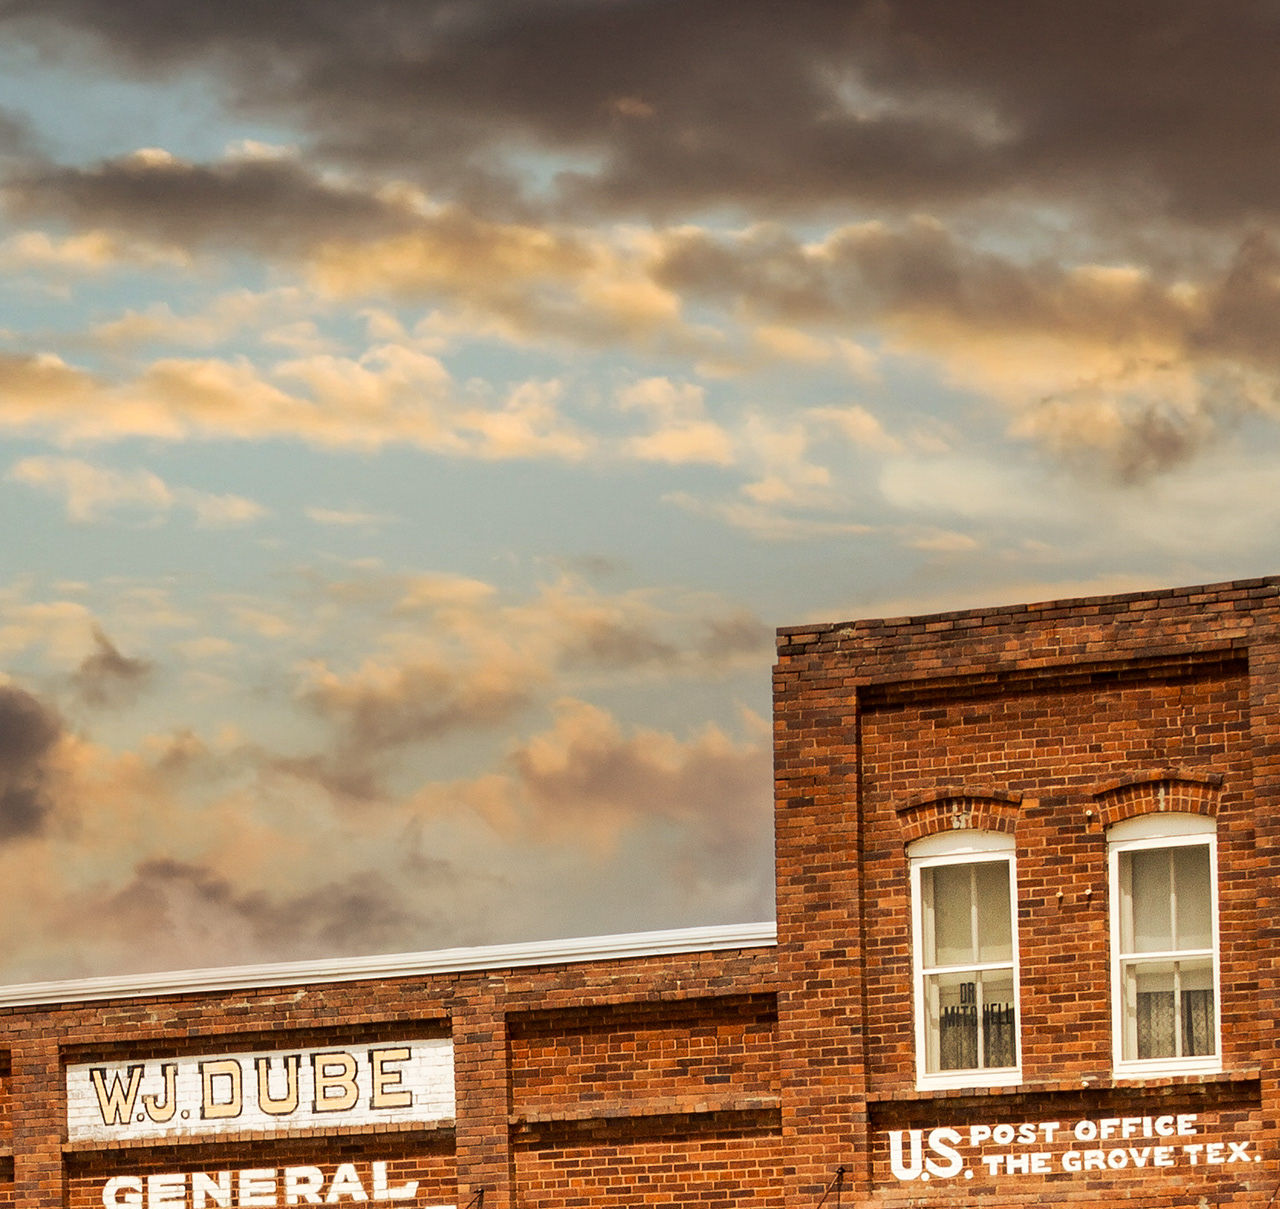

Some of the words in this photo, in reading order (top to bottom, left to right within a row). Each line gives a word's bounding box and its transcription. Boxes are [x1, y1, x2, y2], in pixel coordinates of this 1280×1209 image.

[960, 982, 975, 1004] DR
[89, 1063, 190, 1127] W.J.
[199, 1047, 413, 1120] DUBE
[888, 1126, 974, 1182] U.S.
[970, 1122, 1060, 1147] POST
[1074, 1114, 1198, 1142] OFFICE
[982, 1153, 1052, 1177] THE
[1061, 1146, 1175, 1172] GROVE
[1183, 1141, 1262, 1166] TEX.
